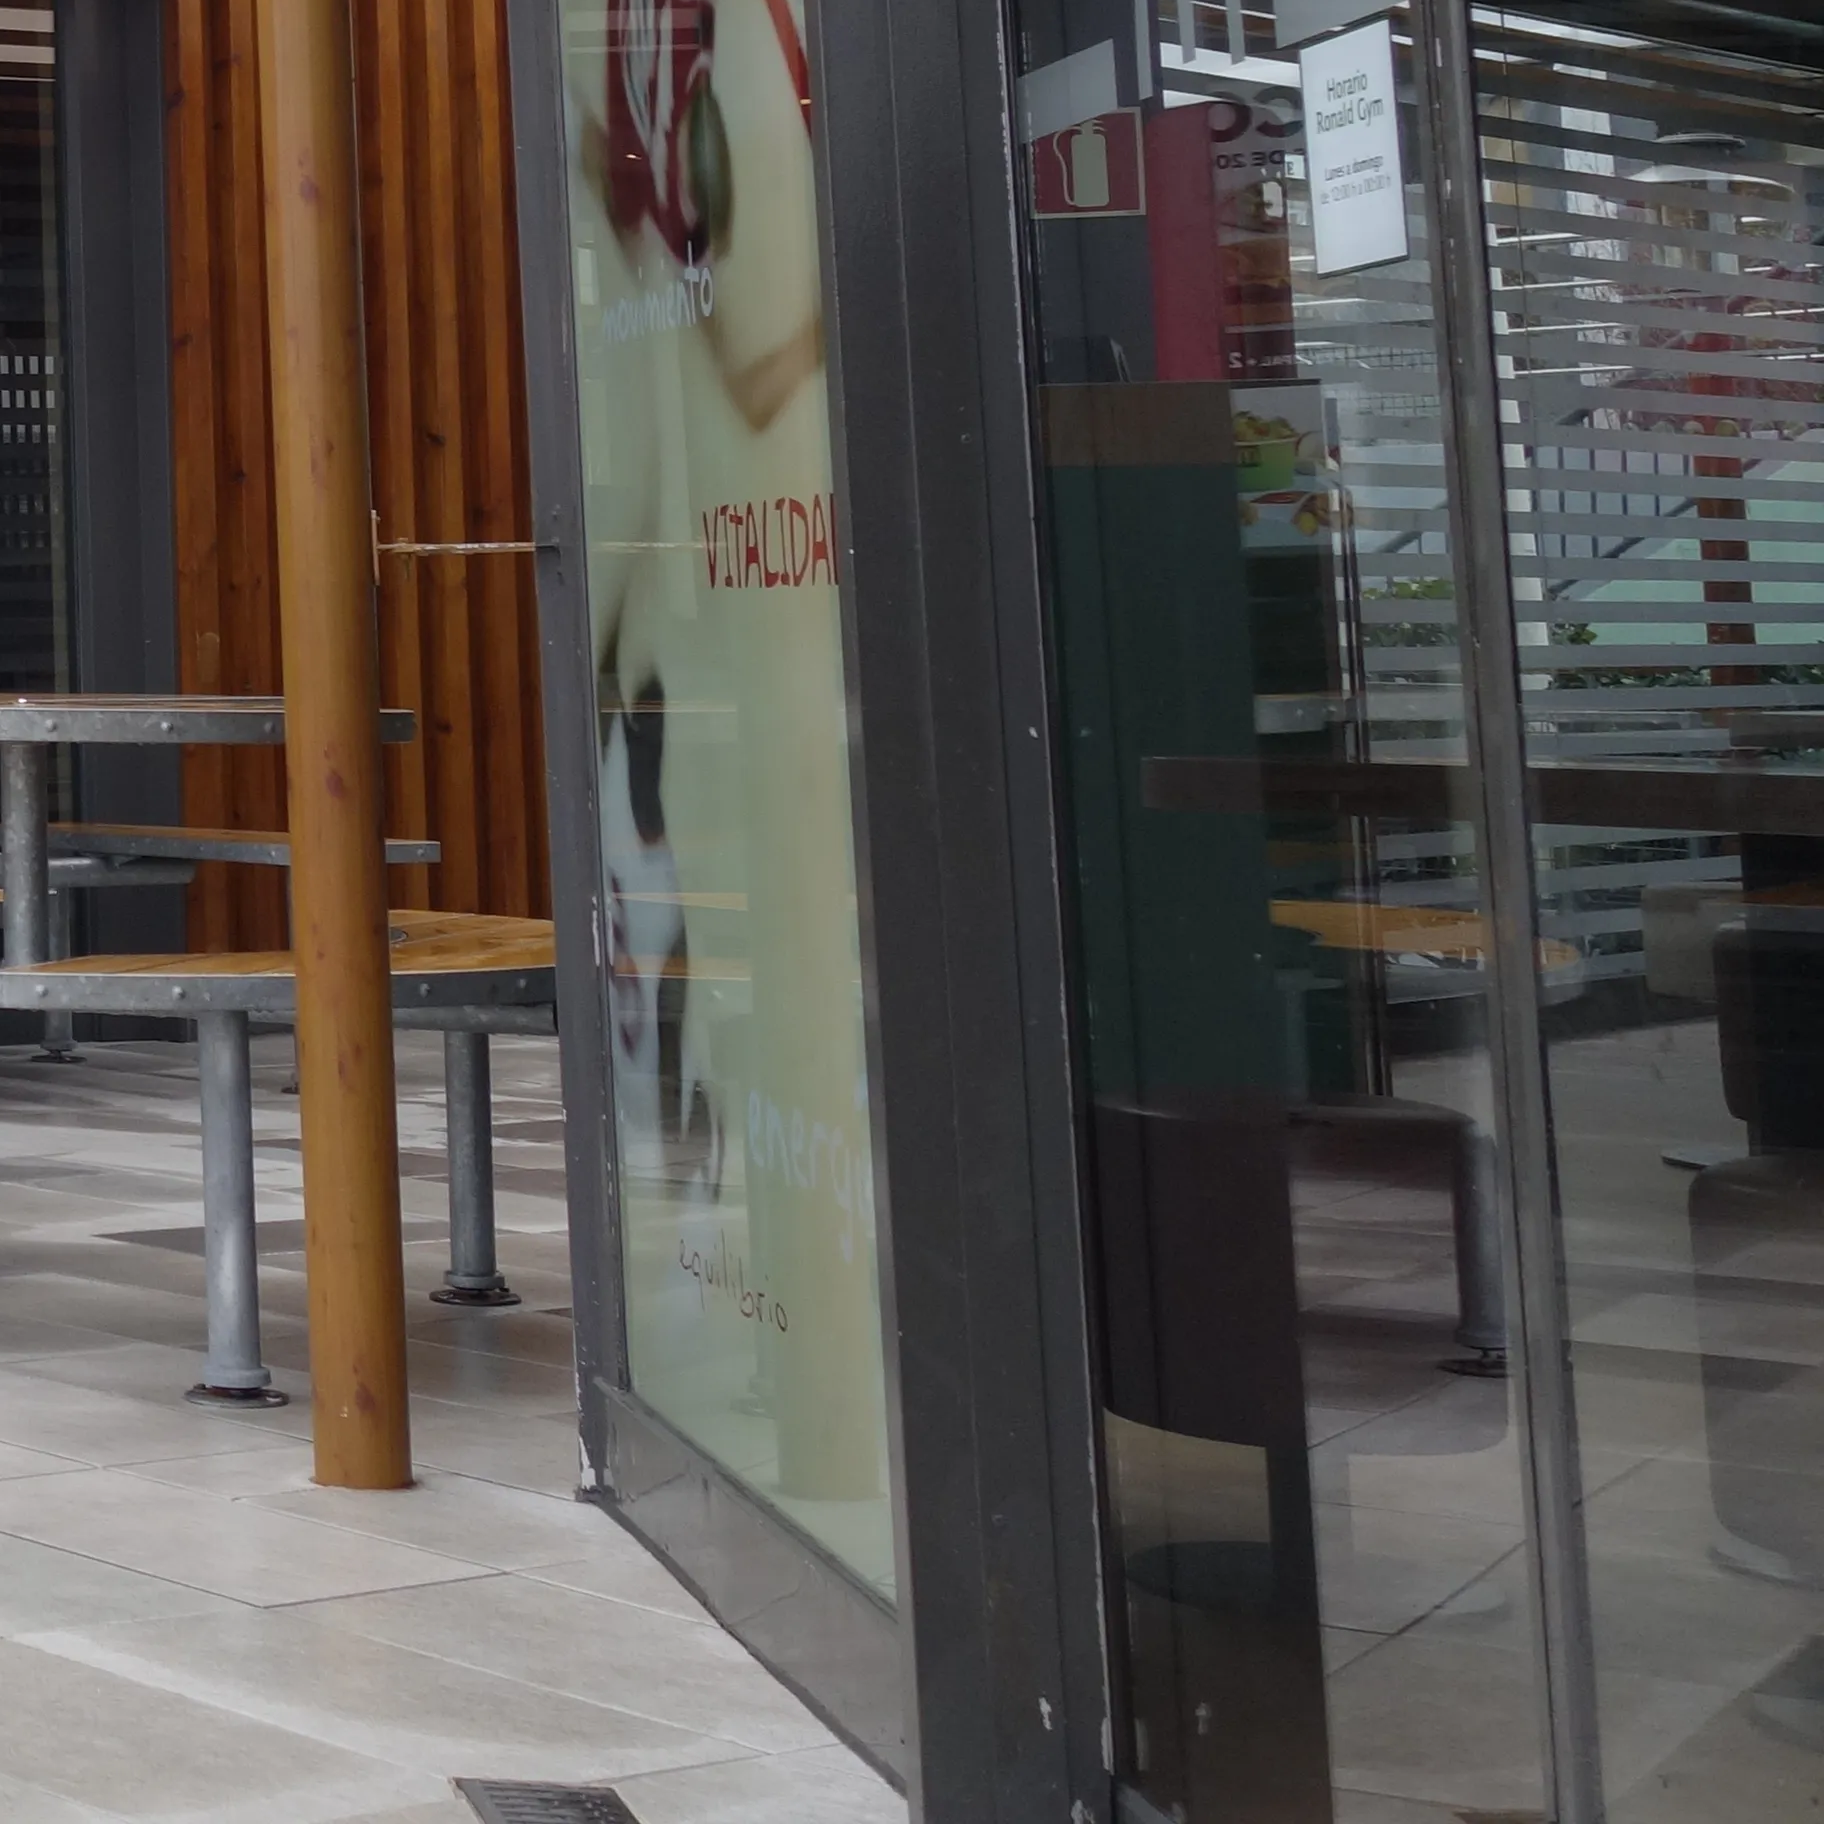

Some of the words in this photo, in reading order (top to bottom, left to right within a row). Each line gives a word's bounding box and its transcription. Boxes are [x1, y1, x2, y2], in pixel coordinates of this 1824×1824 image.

[1326, 70, 1368, 102] Horario
[1316, 103, 1354, 134] Ronald
[1357, 96, 1384, 126] Gym
